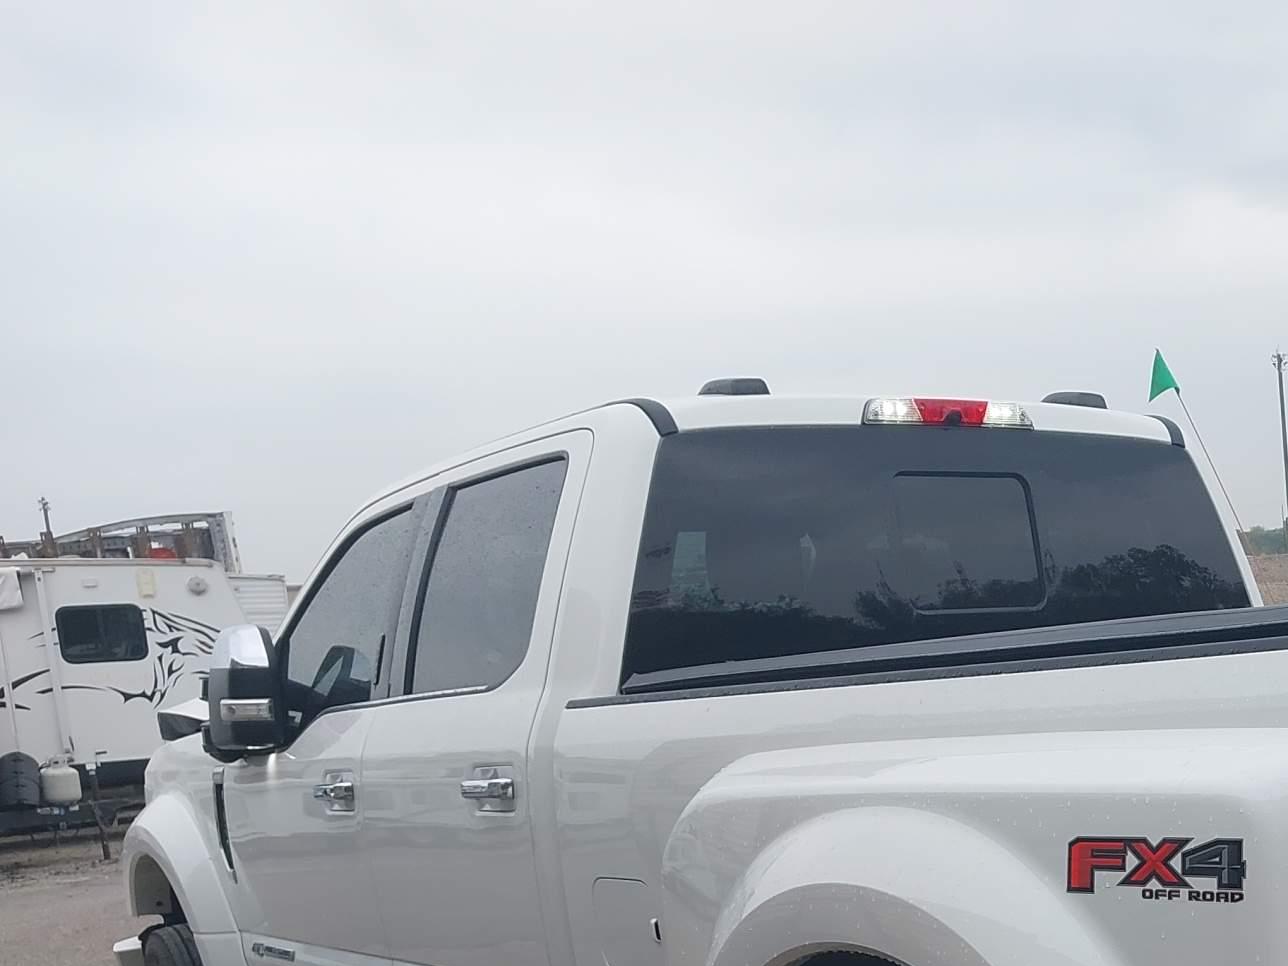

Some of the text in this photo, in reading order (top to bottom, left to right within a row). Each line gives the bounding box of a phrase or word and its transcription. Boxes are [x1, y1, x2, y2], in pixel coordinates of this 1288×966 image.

[1066, 836, 1247, 894] FX4
[1141, 888, 1245, 904] OFF ROAD
